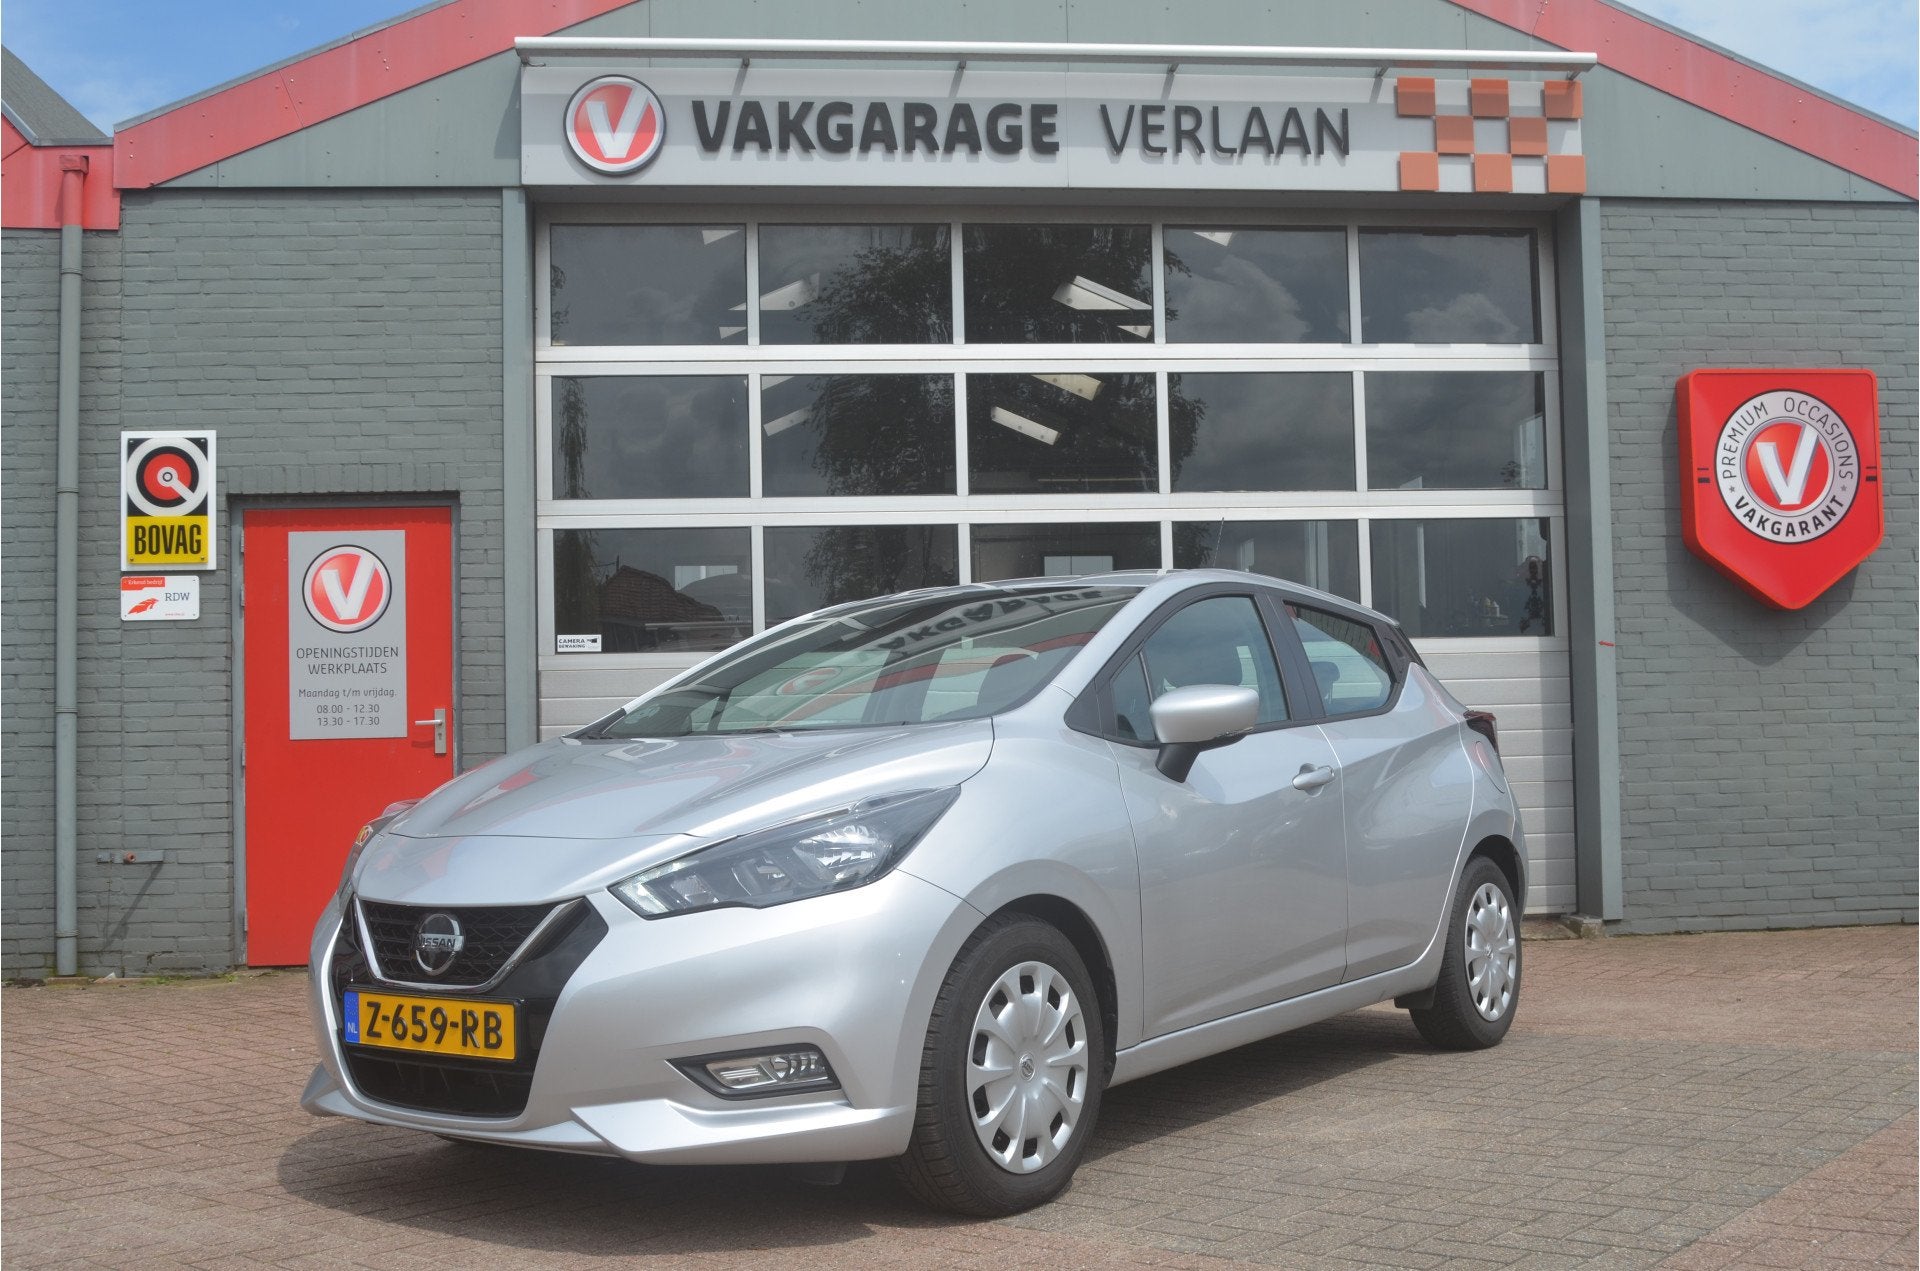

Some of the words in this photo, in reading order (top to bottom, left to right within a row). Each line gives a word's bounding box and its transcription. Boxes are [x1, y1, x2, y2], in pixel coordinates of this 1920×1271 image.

[691, 100, 1060, 155] VAKGARAGE
[1100, 104, 1350, 156] VERLAAN
[1722, 401, 1769, 480] PREMIUM
[1784, 397, 1854, 480] OCCASIONS
[1734, 495, 1844, 537] VAKGARANT
[134, 524, 202, 555] BOVAG
[165, 591, 190, 602] RDW
[296, 646, 399, 659] OPENINGSTIJDEN
[308, 662, 387, 675] WERKPLAATS
[298, 688, 340, 699] Maandag
[342, 688, 360, 698] t/m
[316, 704, 343, 714] 08.00
[353, 704, 380, 714] 12.30
[317, 717, 343, 727] 13.30
[353, 716, 380, 726] 17.30
[347, 1022, 358, 1034] NL
[366, 1001, 503, 1050] Z-659-RB
